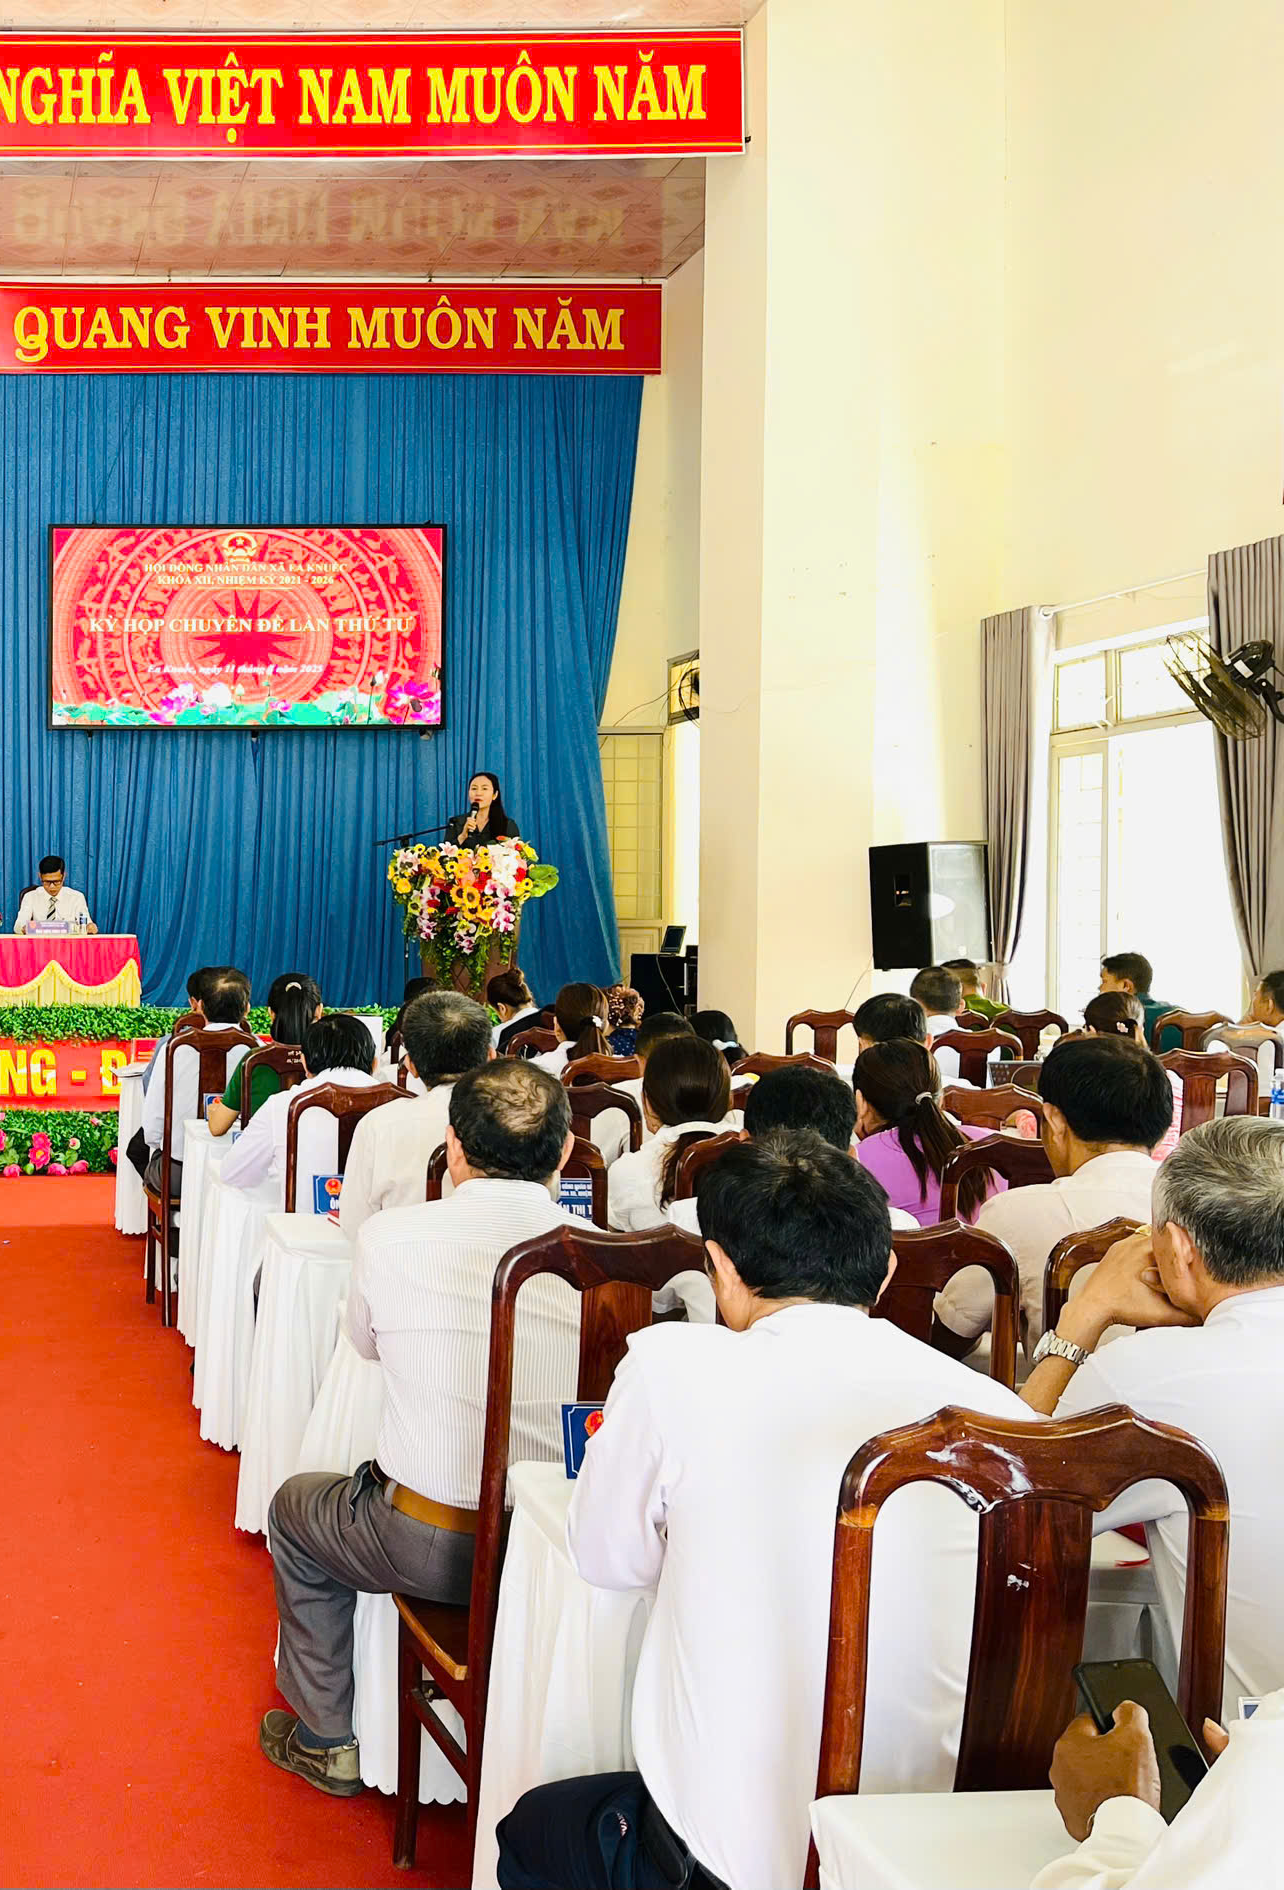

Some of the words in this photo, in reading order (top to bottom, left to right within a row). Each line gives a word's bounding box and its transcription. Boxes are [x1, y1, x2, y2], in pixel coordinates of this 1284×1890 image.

[162, 51, 284, 144] VIỆT
[298, 68, 412, 124] NAM
[426, 50, 578, 124] MUÔN
[593, 50, 707, 121] NĂM
[12, 305, 190, 362] QUANG
[204, 305, 331, 350] VINH
[346, 294, 496, 350] MUÔN
[512, 294, 625, 350] NĂM
[157, 574, 192, 585] KHÓA
[217, 575, 257, 586] NHIỆM
[279, 575, 301, 585] 2021
[311, 575, 334, 585] 2026
[90, 615, 118, 633] KỲ
[123, 618, 165, 635] HỌP
[169, 614, 253, 633] CHUYÊN
[257, 614, 285, 633] ĐỀ
[290, 614, 329, 633] LẦN
[335, 615, 380, 633] THỨ
[382, 615, 414, 633] TƯ
